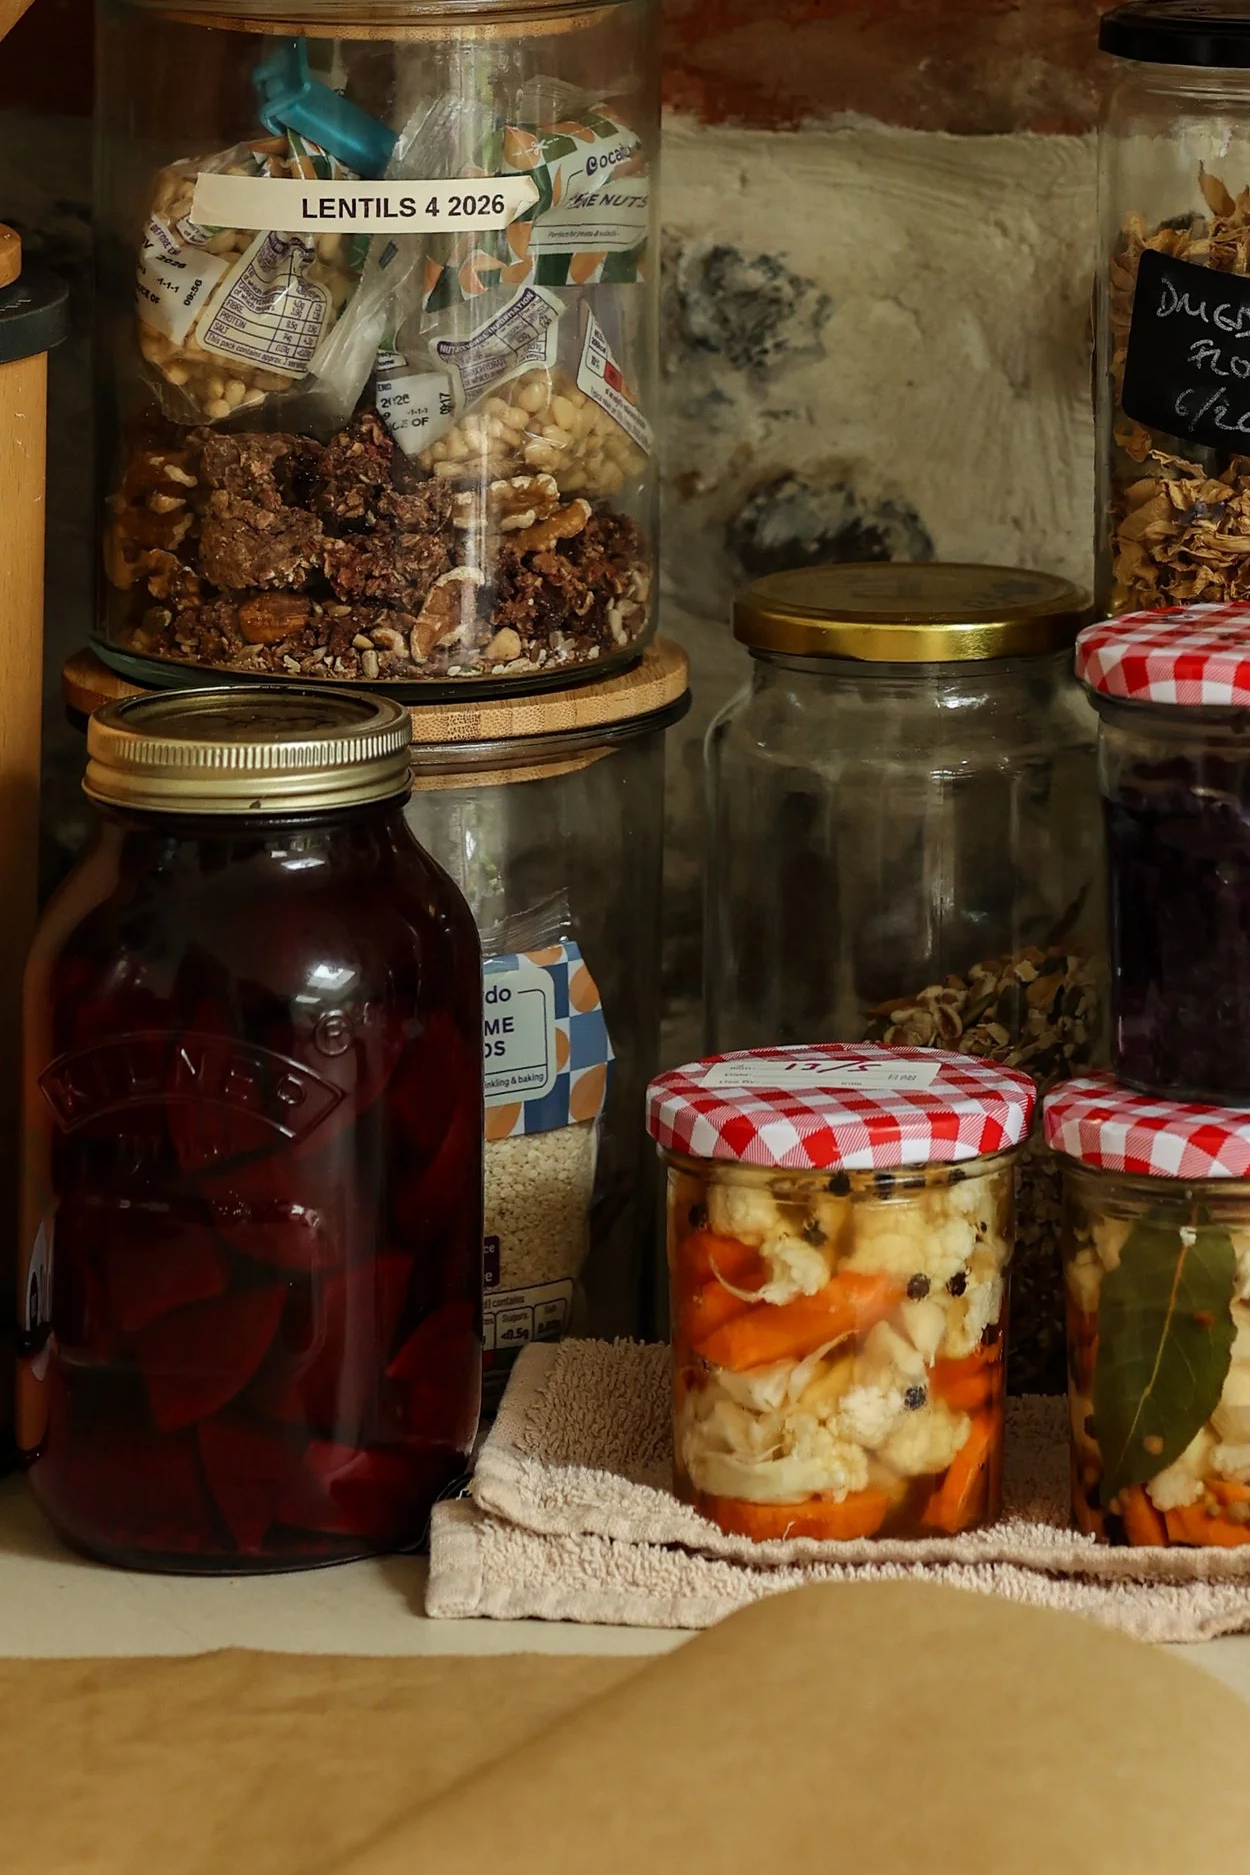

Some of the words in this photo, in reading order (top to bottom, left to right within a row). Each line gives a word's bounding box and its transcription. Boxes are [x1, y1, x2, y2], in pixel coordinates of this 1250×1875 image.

[302, 198, 416, 219] LENTILS
[425, 197, 440, 217] 4
[448, 194, 505, 216] 2026
[217, 310, 248, 329] PROTEIN
[412, 417, 429, 427] OF
[511, 1076, 517, 1084] &
[518, 1073, 544, 1084] baking
